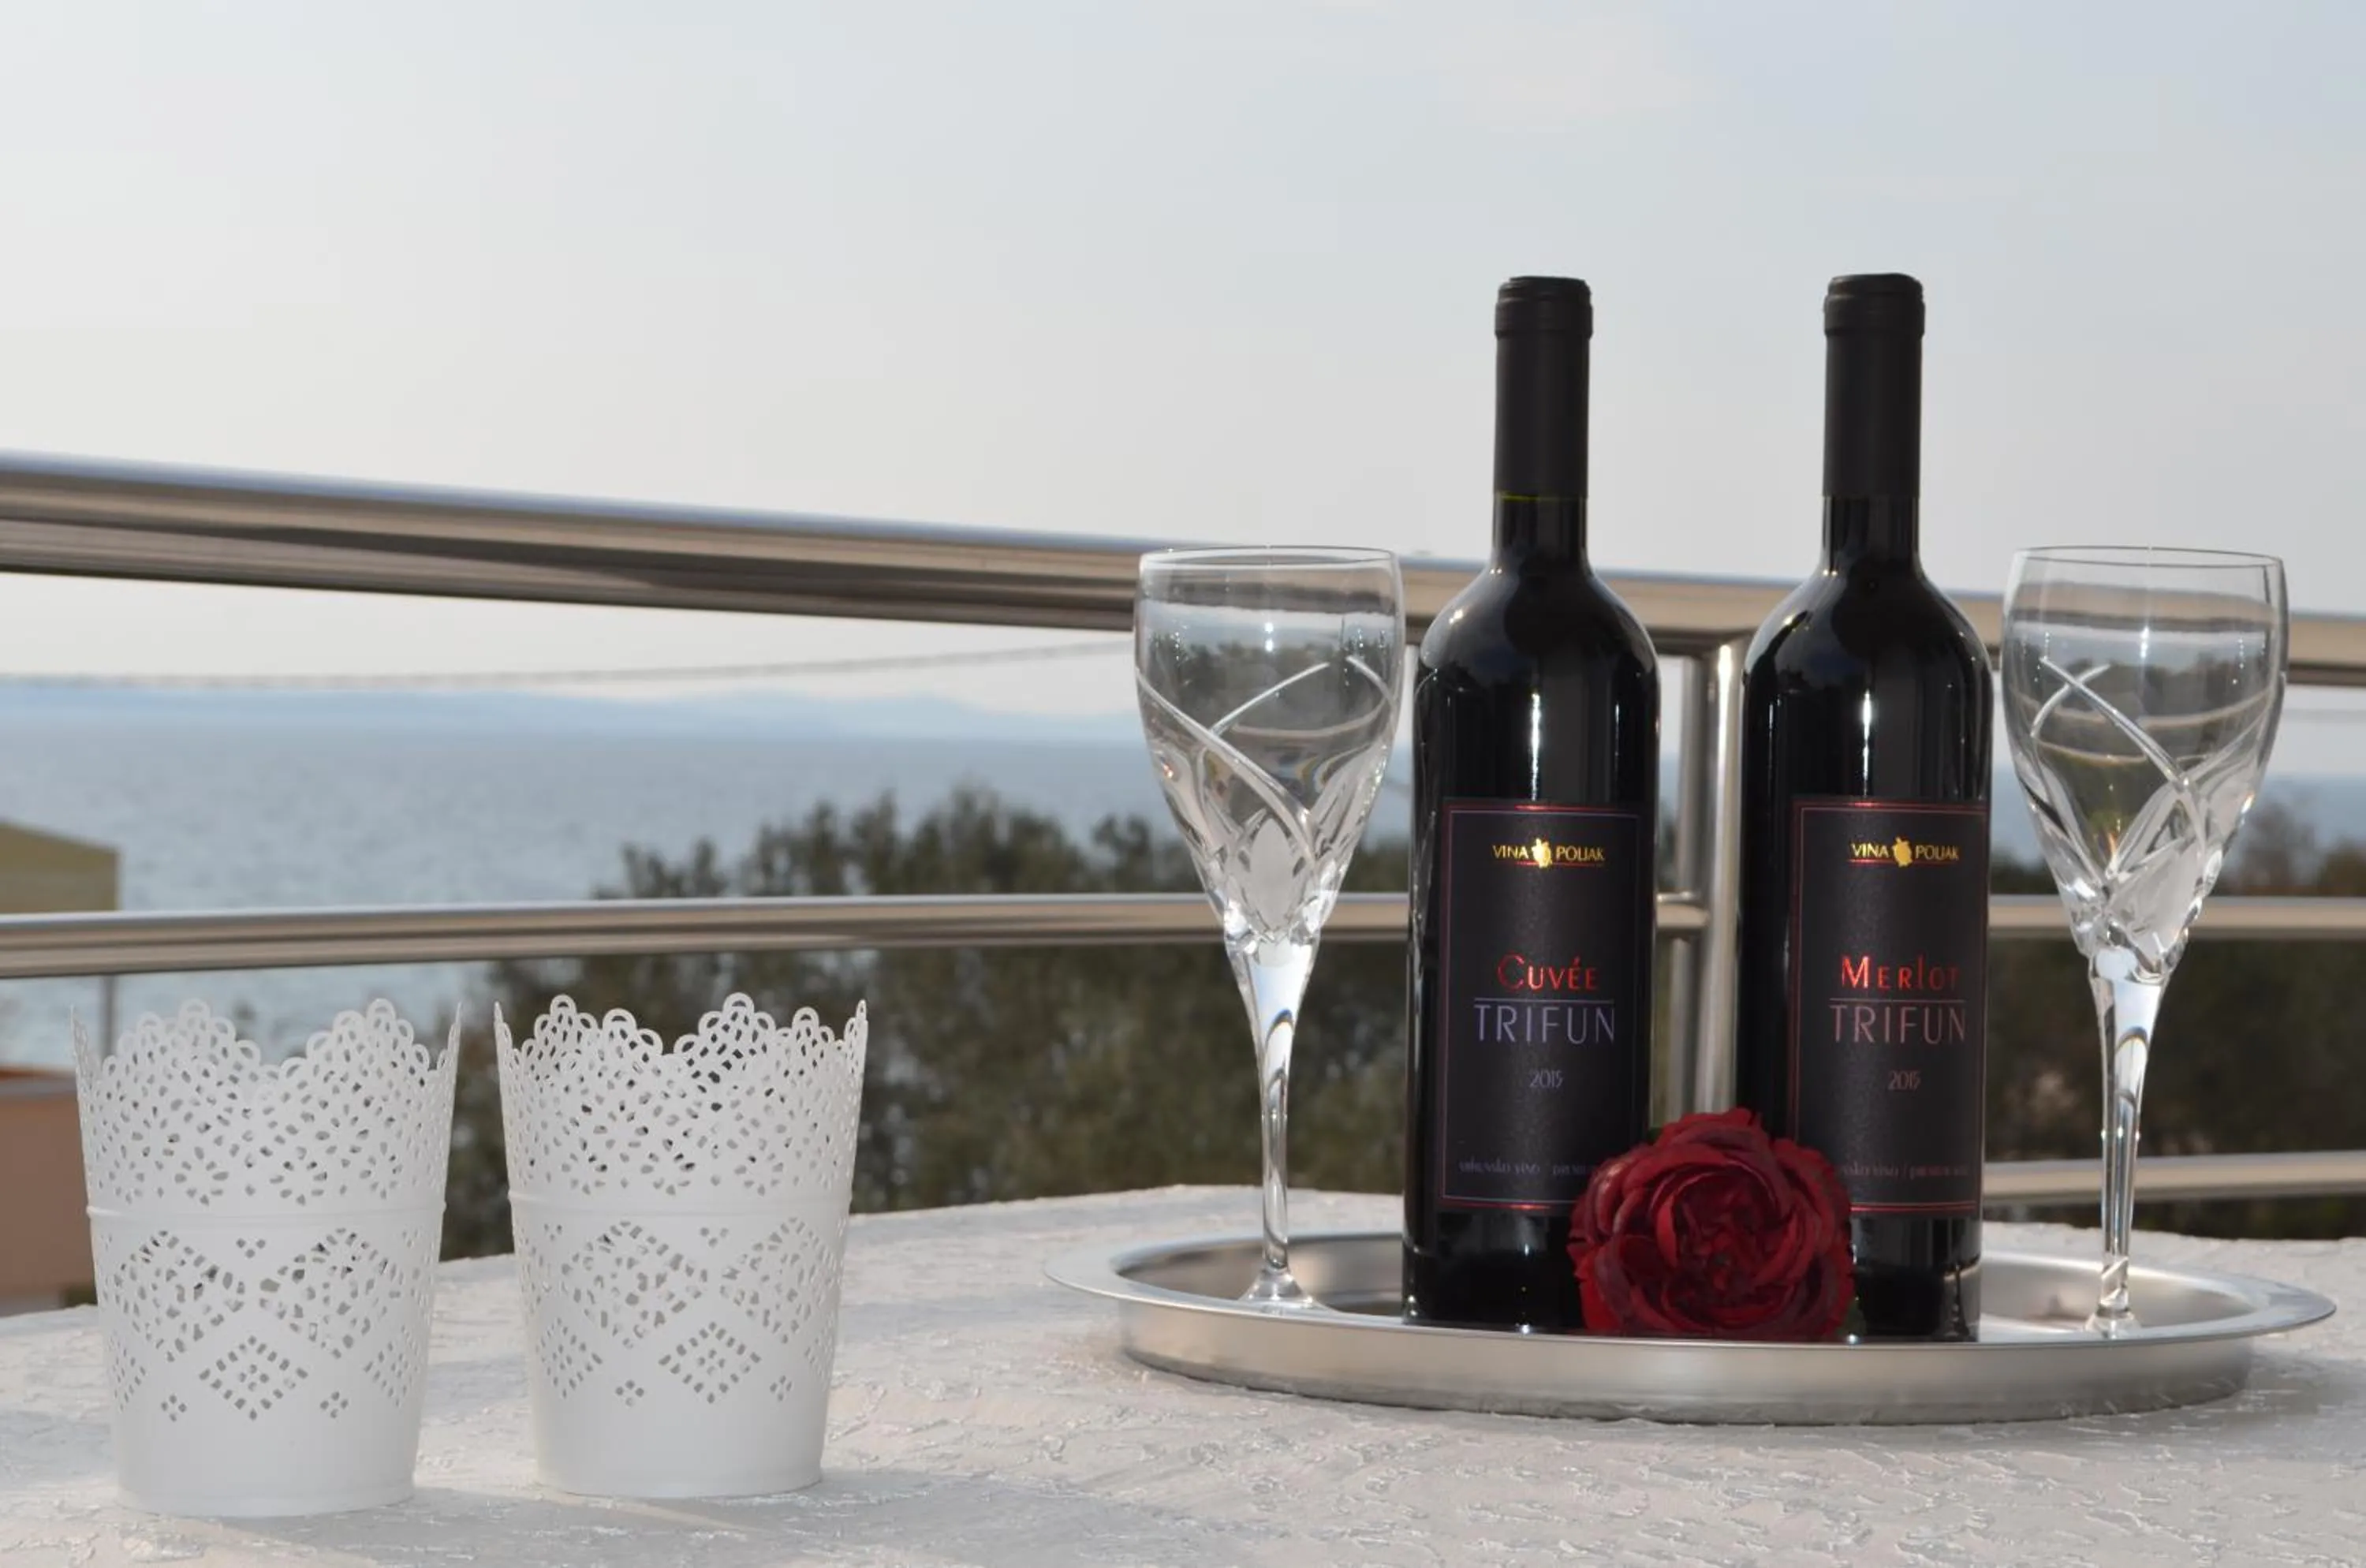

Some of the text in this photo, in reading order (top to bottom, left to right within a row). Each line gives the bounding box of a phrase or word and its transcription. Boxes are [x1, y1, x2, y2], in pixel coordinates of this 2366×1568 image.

[1491, 845, 1529, 860] VINA
[1850, 842, 1890, 859] VINA
[1473, 1004, 1615, 1045] TRIFUN
[1829, 1004, 1966, 1045] TRIFUN
[1528, 1069, 1564, 1088] 2015
